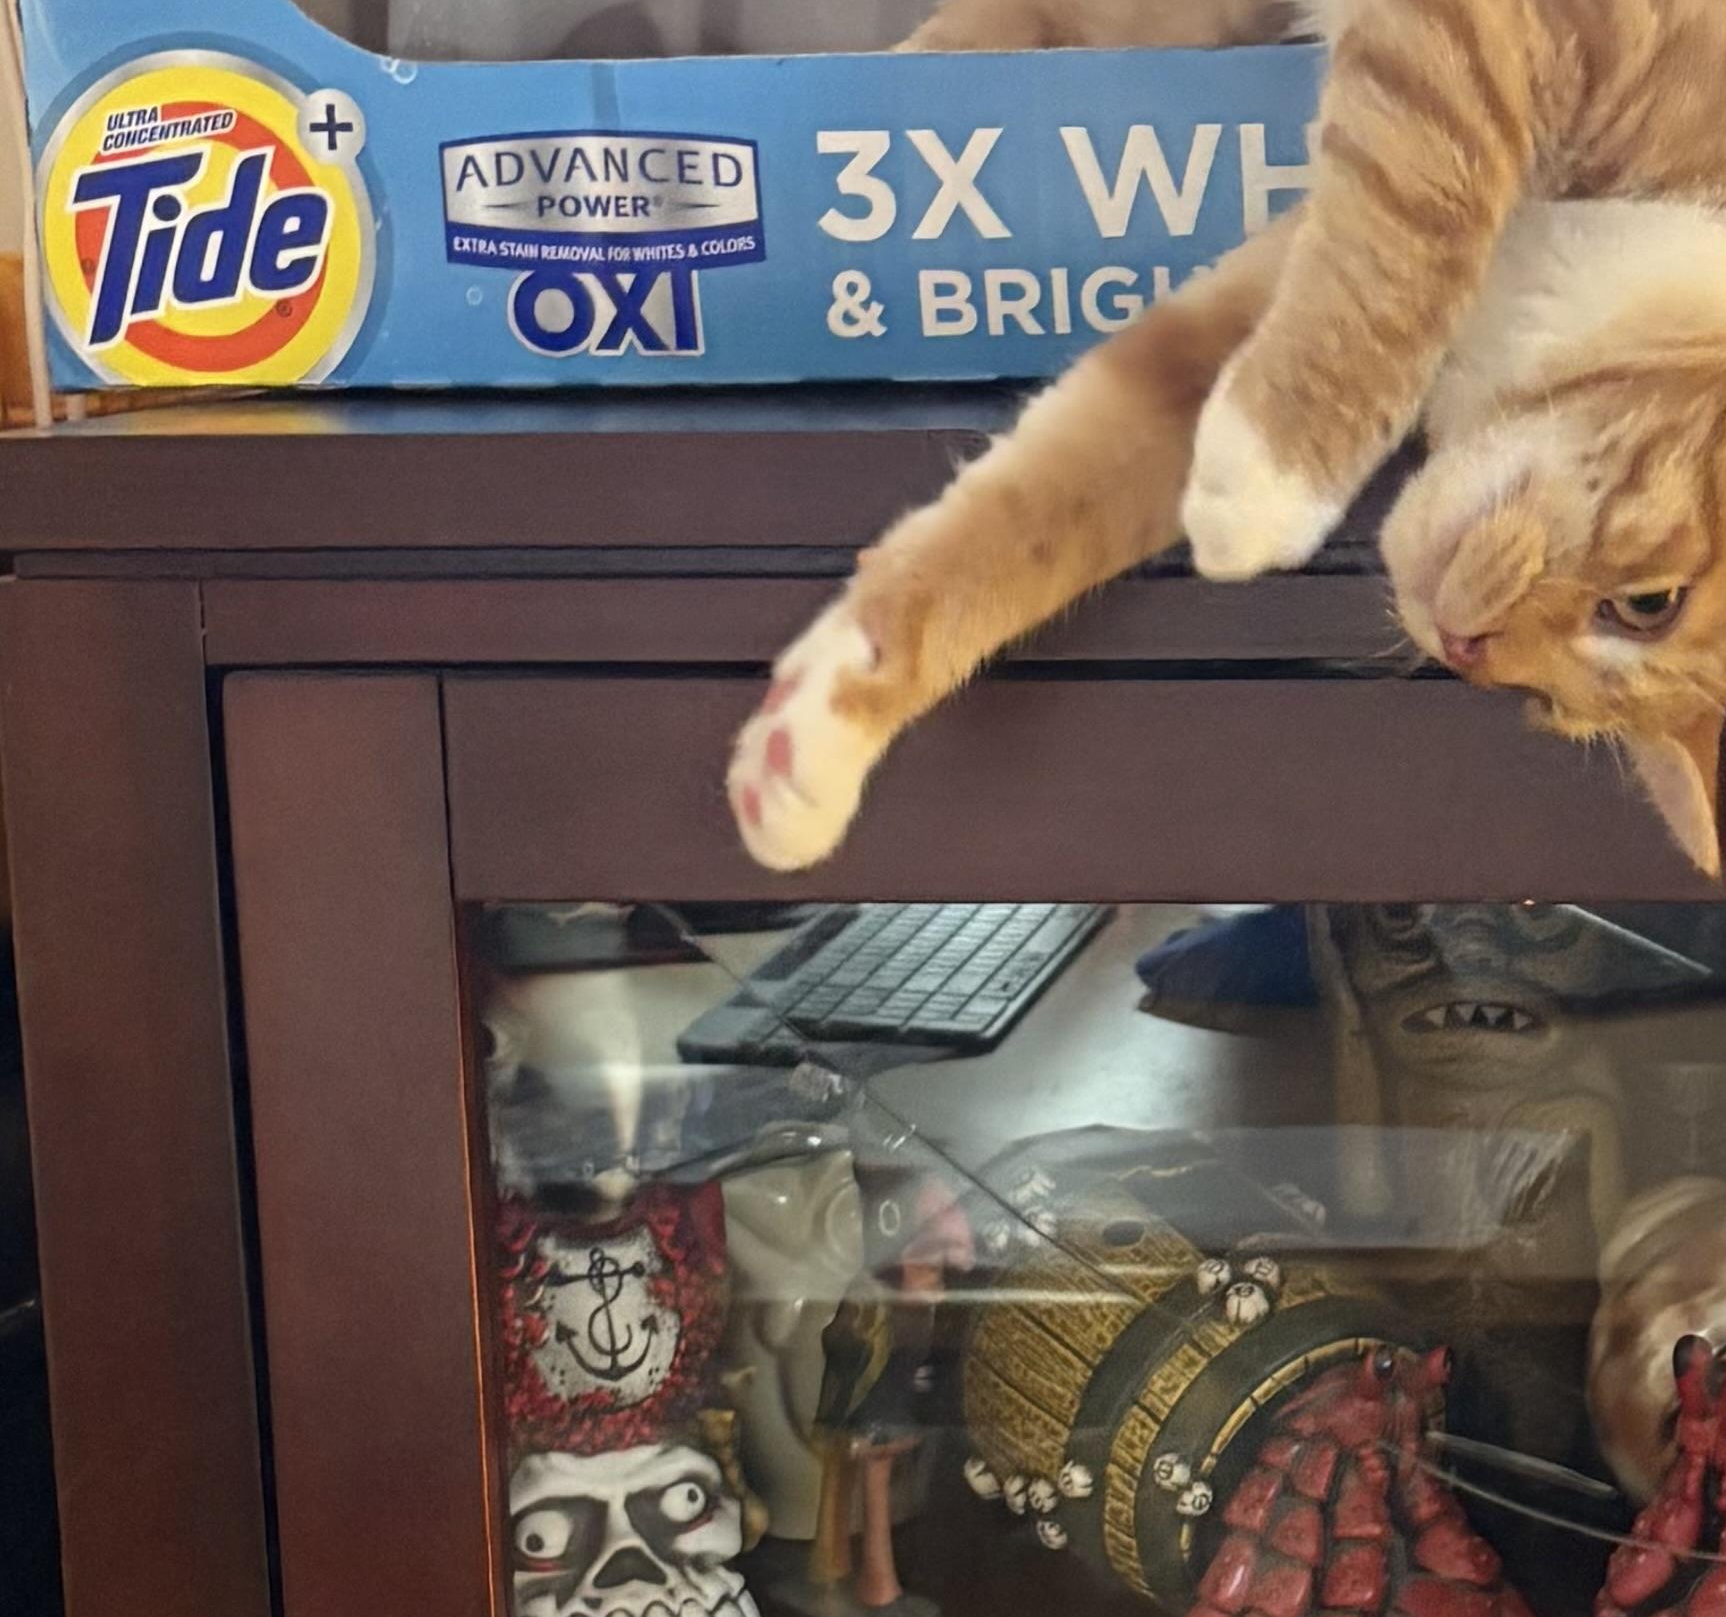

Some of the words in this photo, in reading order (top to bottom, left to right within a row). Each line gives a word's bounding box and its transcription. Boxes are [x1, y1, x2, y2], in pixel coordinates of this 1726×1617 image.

[103, 111, 234, 152] CONCENTRATED
[107, 106, 158, 131] ULTRA
[456, 146, 743, 191] ADVANCED
[816, 127, 1012, 242] 3X
[1058, 123, 1324, 239] WH
[73, 149, 331, 347] Tide
[453, 236, 497, 256] EXTRA
[499, 241, 539, 259] STAIN
[541, 244, 605, 261] REMOVAL
[608, 245, 631, 260] FOR
[633, 243, 684, 260] WHITES
[688, 243, 698, 258] &
[701, 235, 756, 256] COLORS
[512, 269, 699, 353] OXI
[827, 269, 887, 338] &
[918, 266, 1170, 337] BRIG
